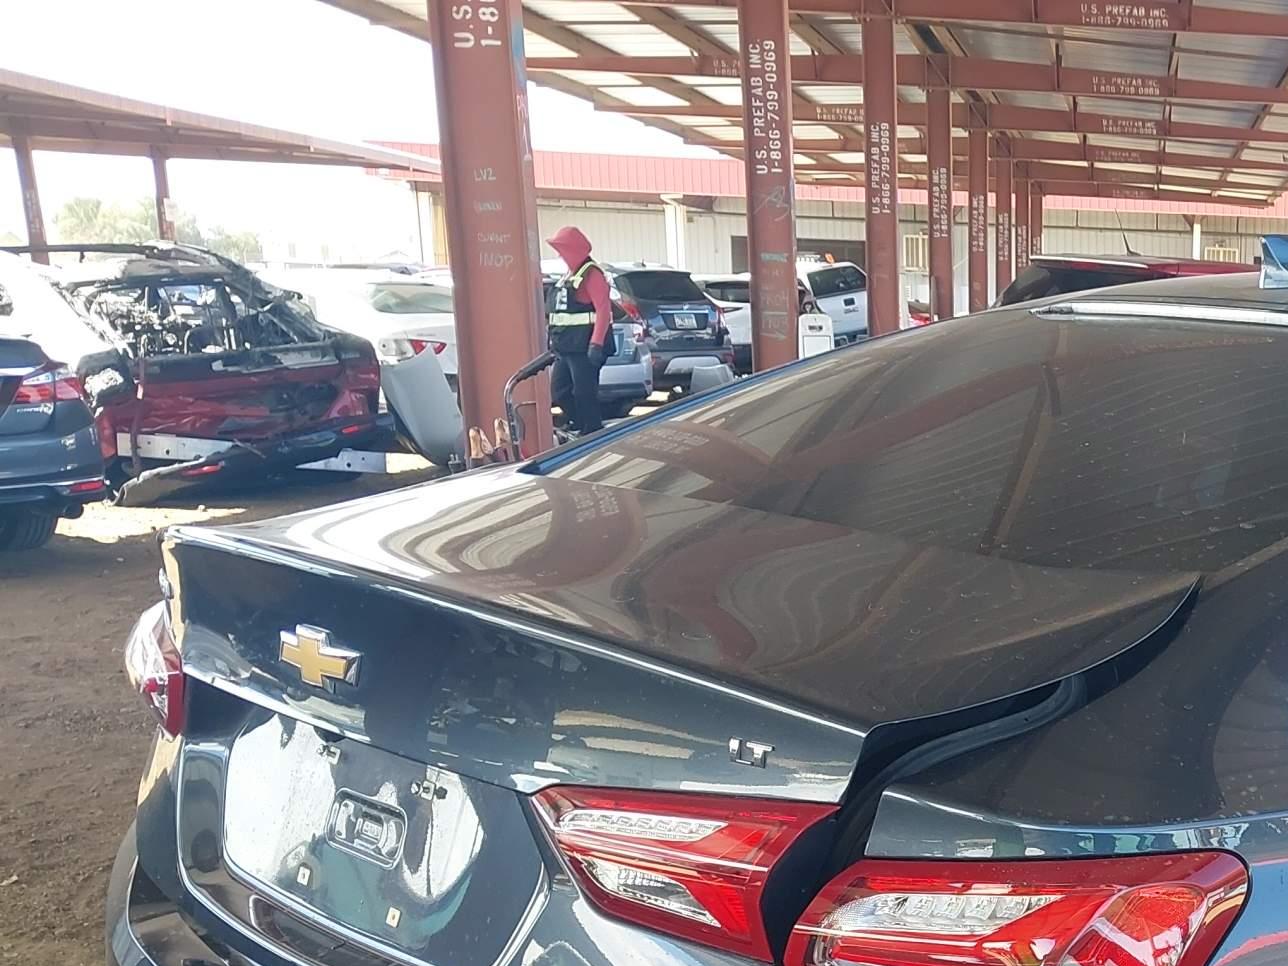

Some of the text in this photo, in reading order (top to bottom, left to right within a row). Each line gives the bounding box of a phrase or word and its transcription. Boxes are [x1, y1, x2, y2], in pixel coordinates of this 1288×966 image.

[478, 0, 502, 47] 1-8
[1081, 3, 1169, 18] U.S. PREFAB INC.
[749, 39, 769, 175] U.S. PREFAB INC.
[763, 40, 783, 173] 1-866-799-0969
[870, 121, 881, 214] U.S. PREFAB INC.
[880, 122, 892, 214] 1-866-799-0969
[729, 737, 775, 768] LT
